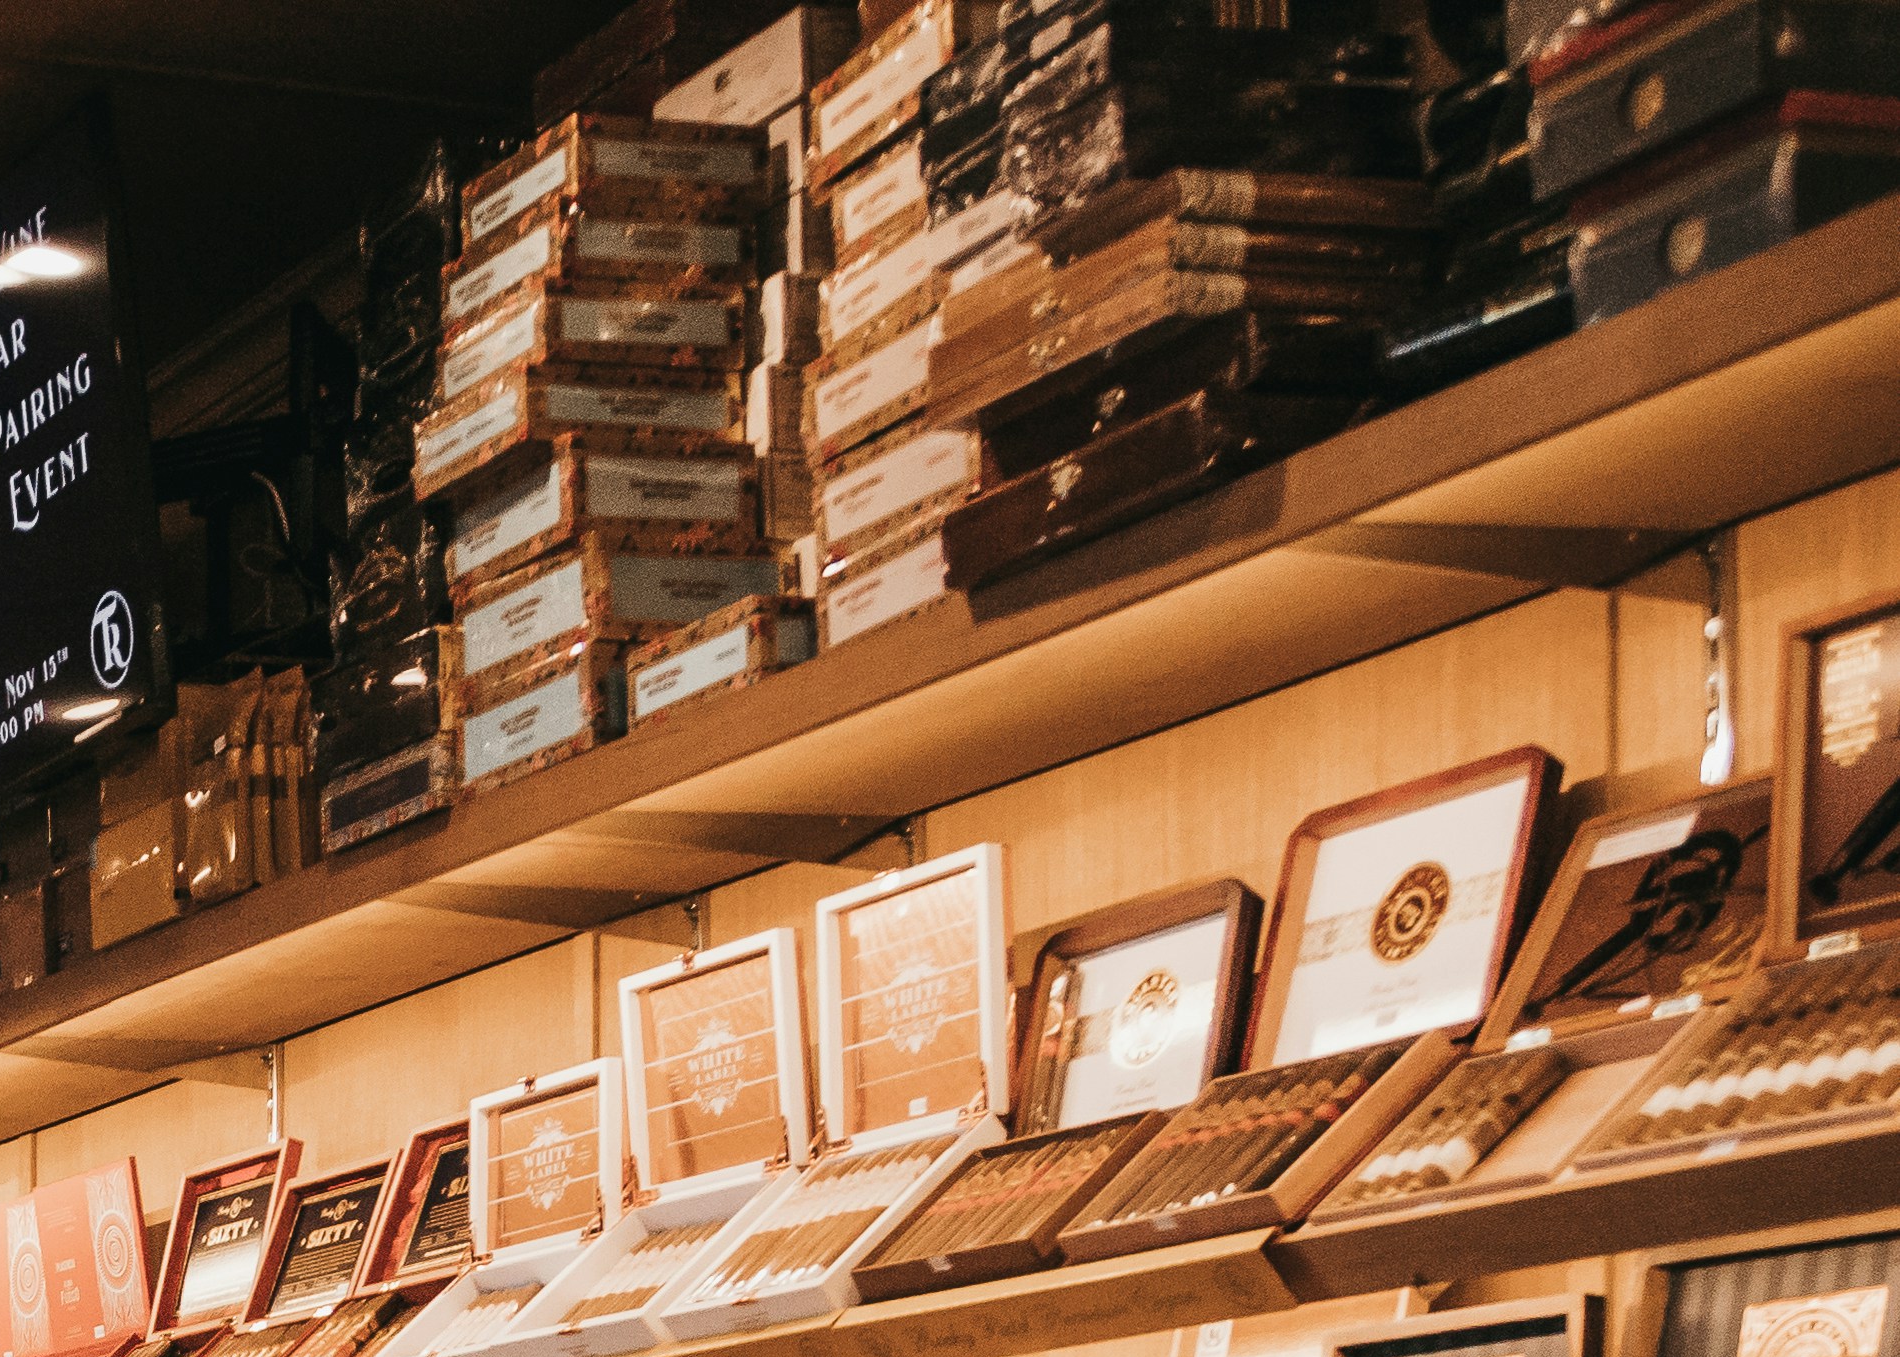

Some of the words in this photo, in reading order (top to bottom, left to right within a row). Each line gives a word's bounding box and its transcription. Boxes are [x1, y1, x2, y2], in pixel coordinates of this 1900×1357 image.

[9, 431, 91, 532] EVENT
[4, 669, 36, 713] NOV
[22, 700, 46, 737] PM
[687, 1044, 747, 1072] WHITE
[694, 1063, 739, 1087] LABEL
[521, 1143, 576, 1171] WHITE
[527, 1159, 574, 1182] LABEL
[206, 1217, 254, 1247] SIXTY
[305, 1218, 358, 1250] SIXTY
